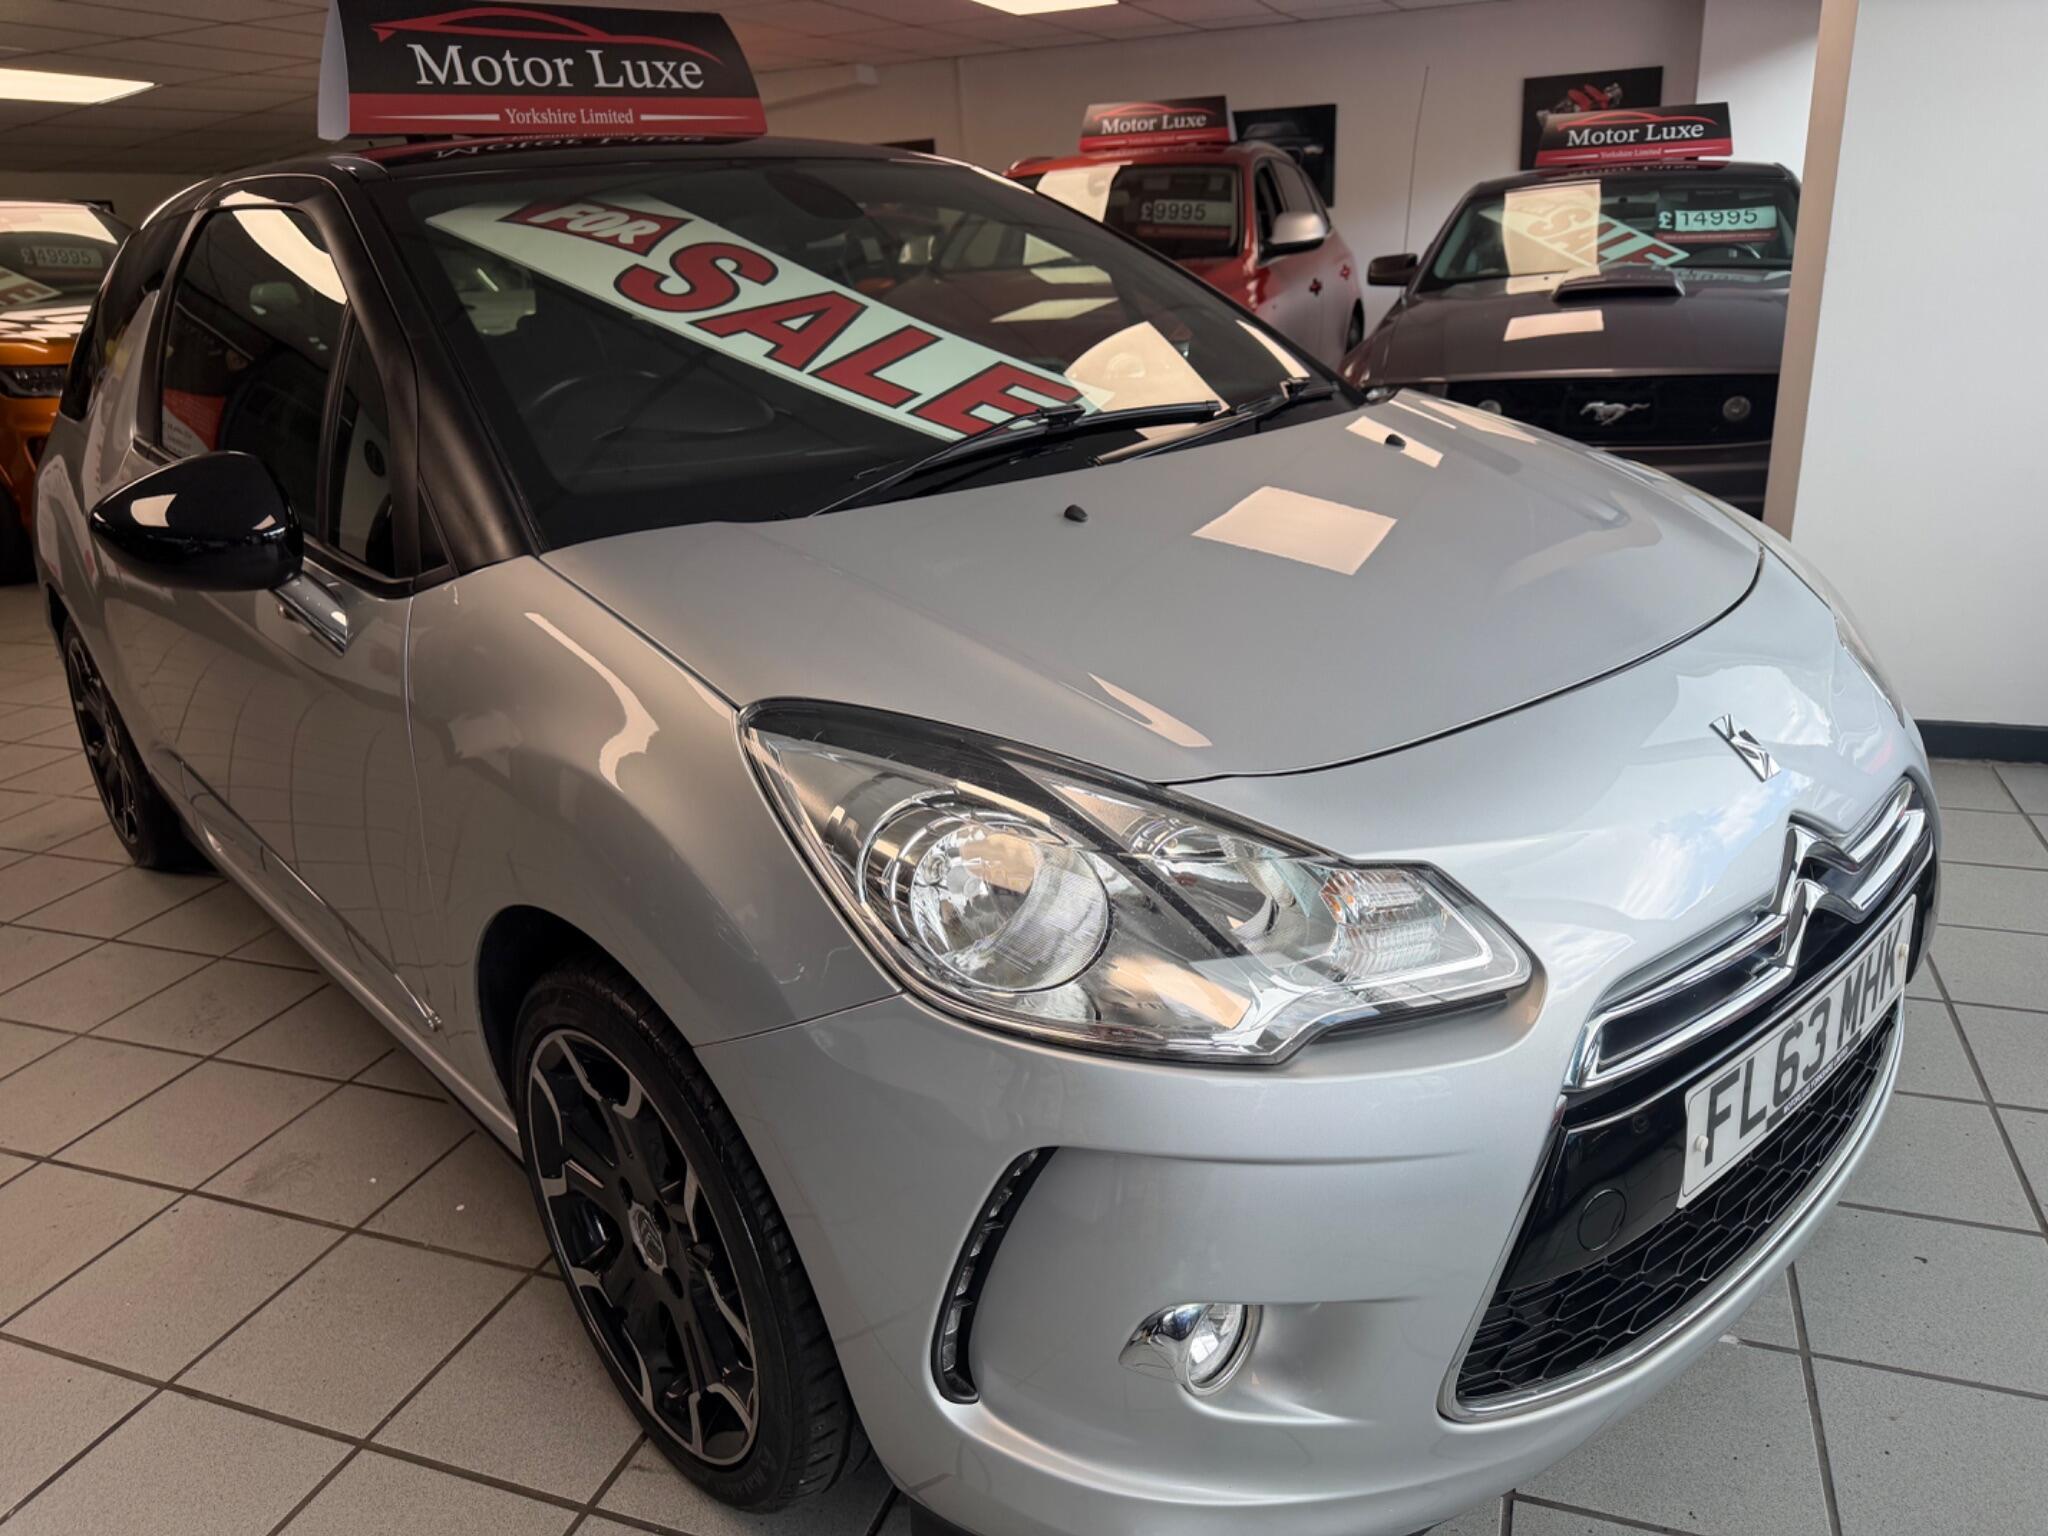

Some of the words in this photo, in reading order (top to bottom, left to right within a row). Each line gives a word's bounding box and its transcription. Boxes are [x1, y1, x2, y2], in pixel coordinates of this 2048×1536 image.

[406, 43, 573, 87] Motor
[586, 49, 704, 90] Luxe
[505, 108, 577, 125] Yorkshire
[580, 108, 634, 125] Limited
[1101, 117, 1157, 135] Motor
[1162, 114, 1207, 130] Luxe
[1566, 128, 1639, 147] Motor
[1645, 123, 1704, 141] Luxe
[535, 203, 661, 246] FOR
[1658, 209, 1758, 229] £14995
[613, 241, 1086, 438] SALE
[1704, 996, 1831, 1167] FL63
[1837, 917, 1904, 1050] MHK
